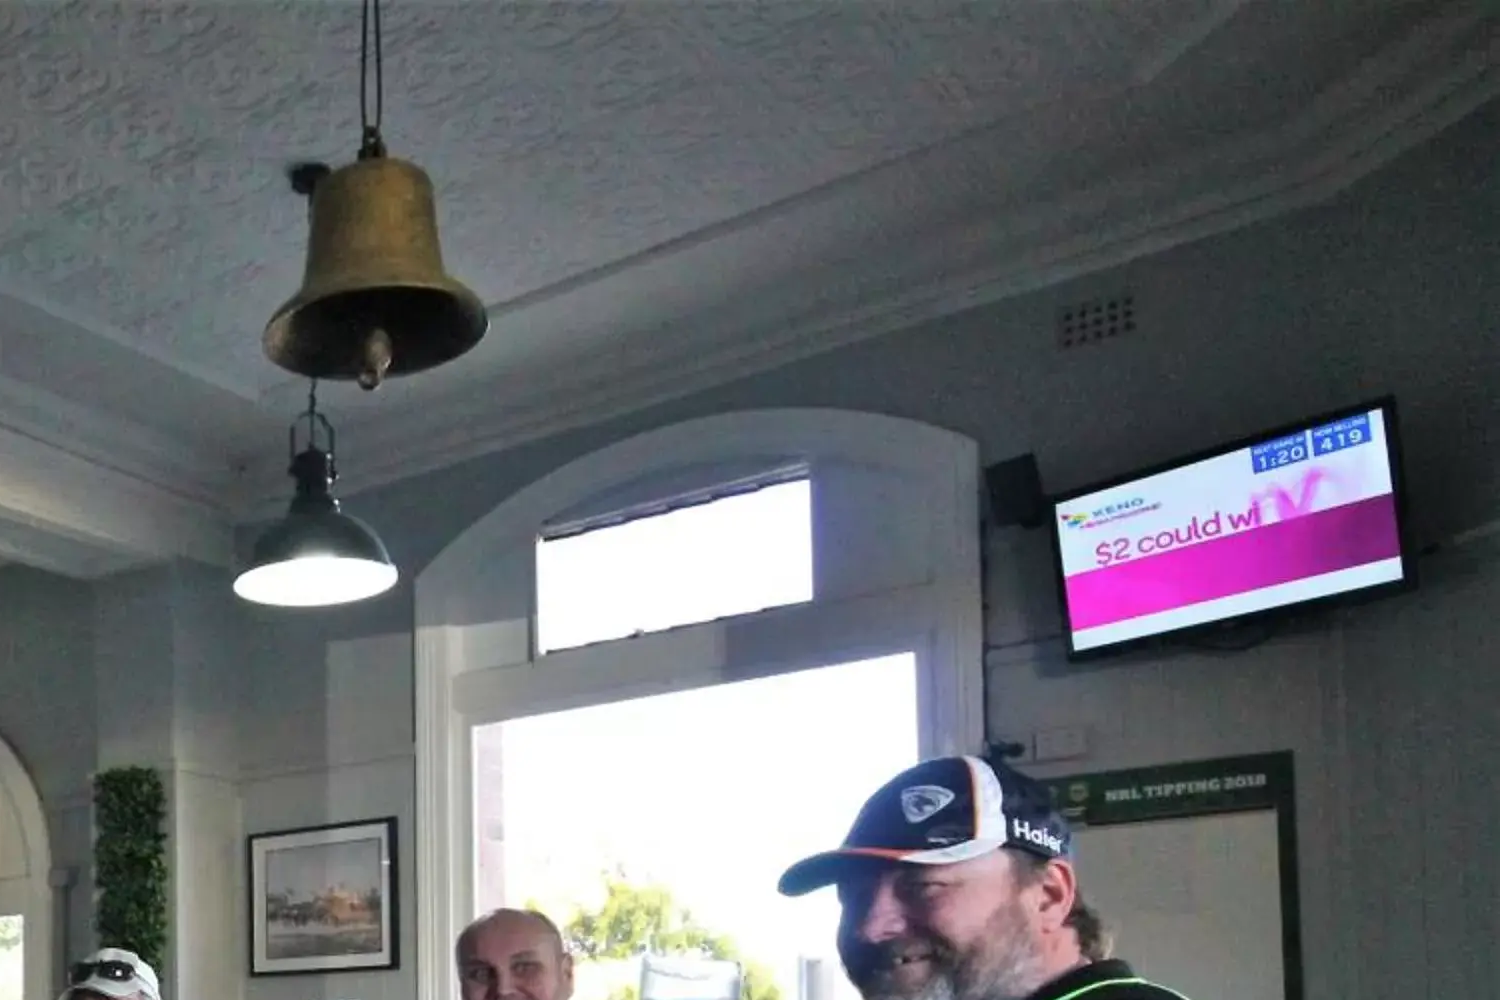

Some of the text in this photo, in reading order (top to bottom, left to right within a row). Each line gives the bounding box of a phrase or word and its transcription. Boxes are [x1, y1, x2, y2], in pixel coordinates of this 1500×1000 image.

[1321, 428, 1363, 450] 419
[1259, 445, 1305, 470] 1:20
[1094, 537, 1132, 566] $2
[1137, 509, 1222, 554] could
[1143, 777, 1221, 799] TIPPING
[1224, 773, 1268, 790] 2018
[1012, 817, 1064, 854] Haier
